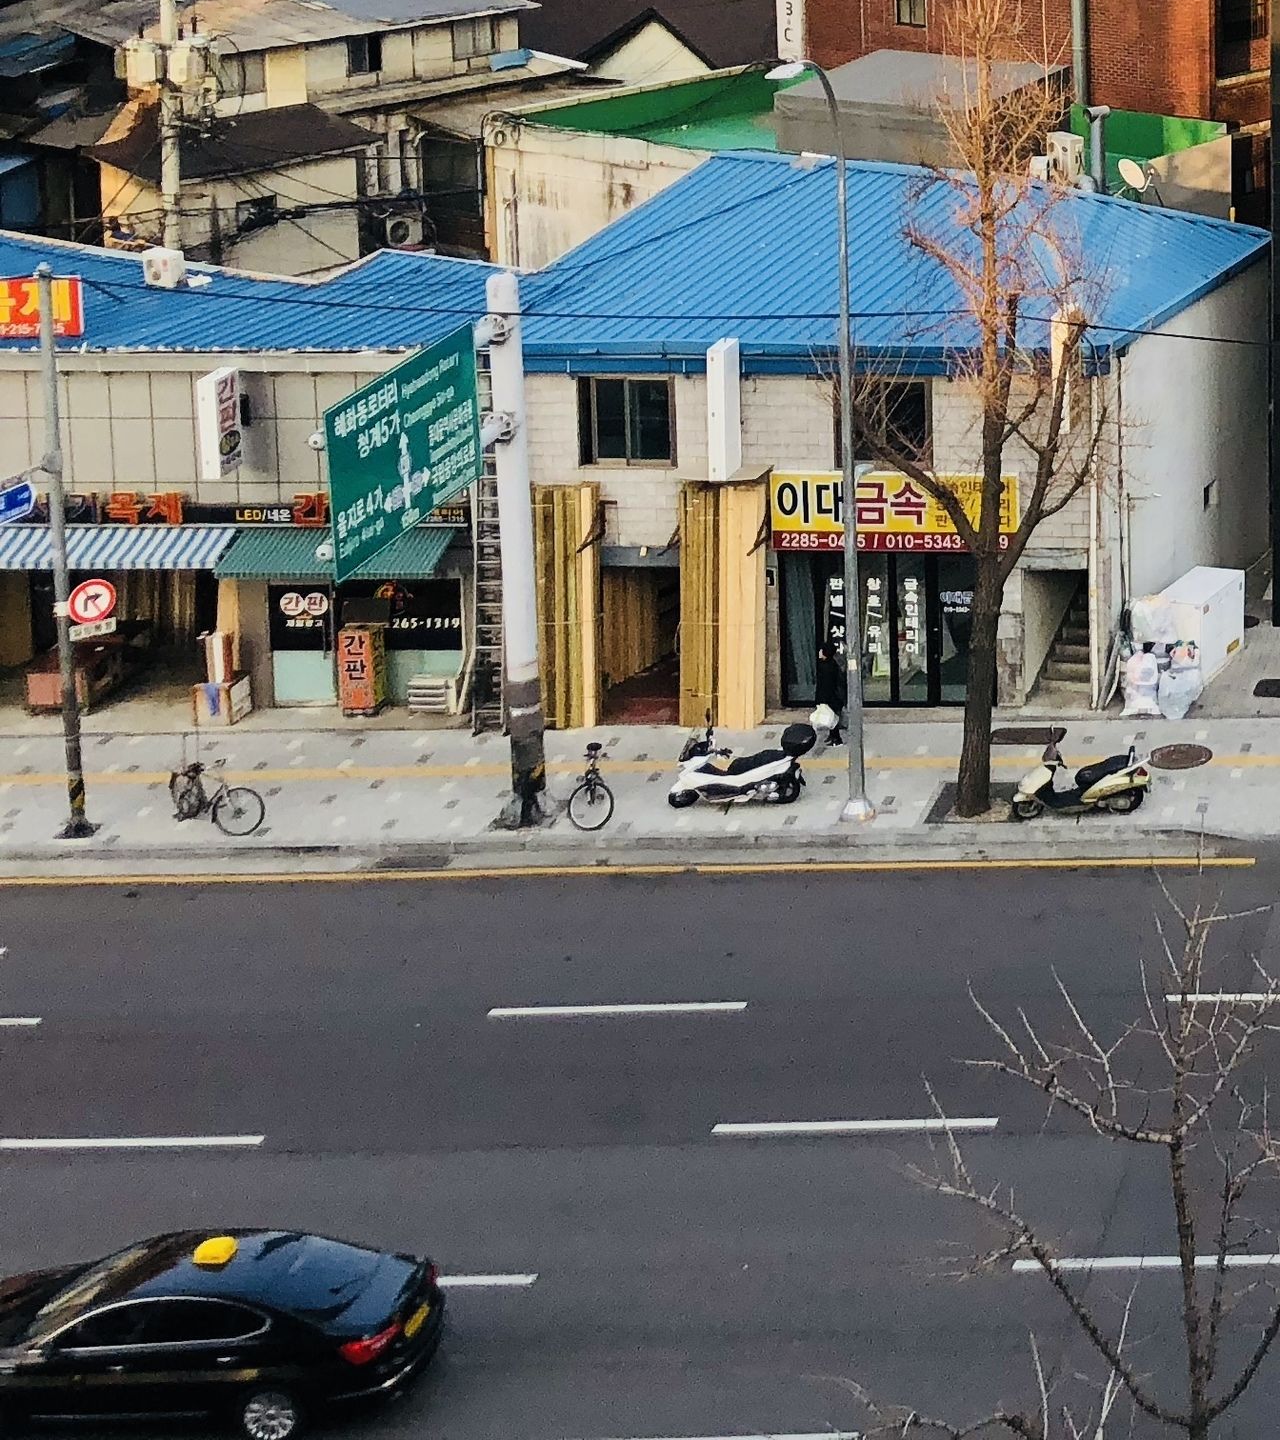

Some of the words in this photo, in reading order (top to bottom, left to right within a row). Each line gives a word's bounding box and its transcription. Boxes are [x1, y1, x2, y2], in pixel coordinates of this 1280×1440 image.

[235, 507, 291, 523] LED/네온
[781, 533, 866, 549] 2285-045
[343, 634, 368, 680] 간판
